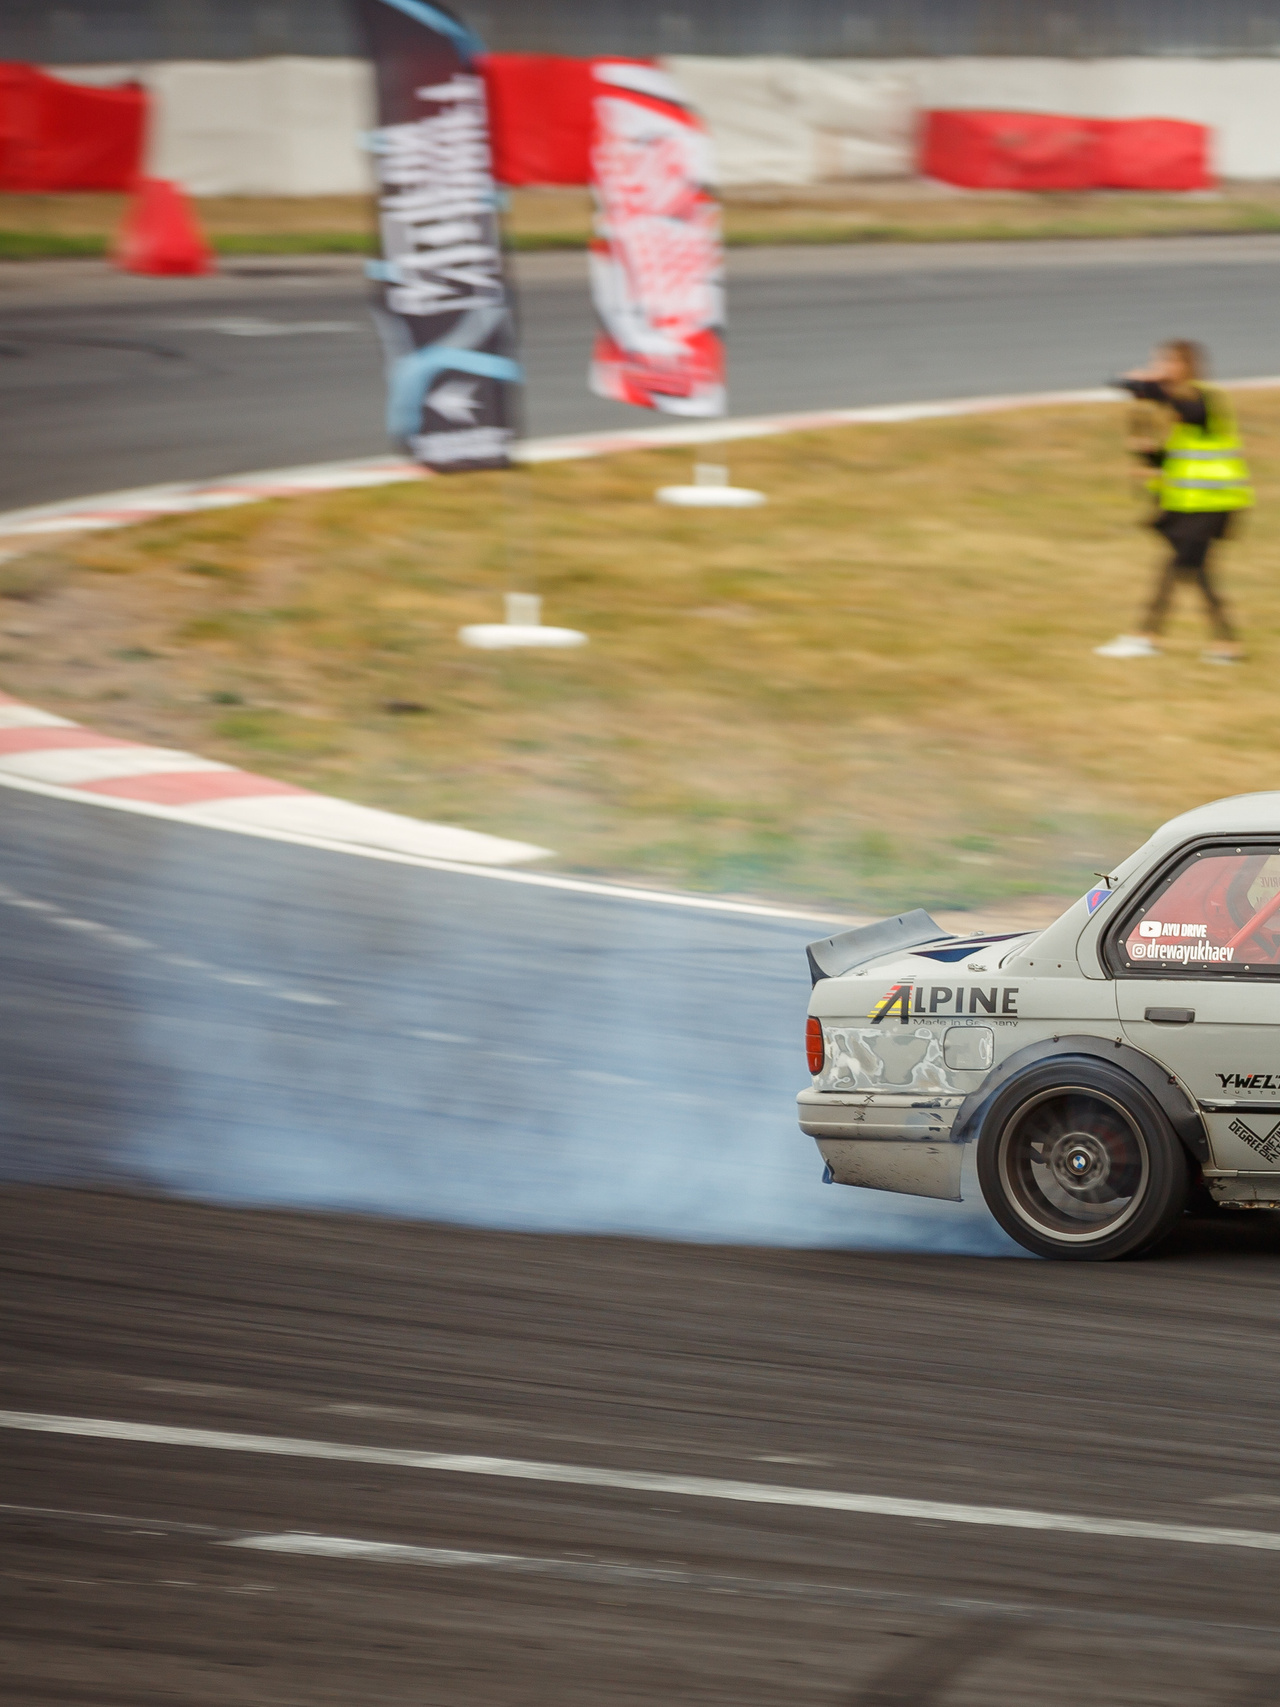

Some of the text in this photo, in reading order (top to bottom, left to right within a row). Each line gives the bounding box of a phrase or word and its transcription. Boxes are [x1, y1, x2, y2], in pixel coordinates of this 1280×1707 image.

[1161, 922, 1208, 938] AYU DRIVE
[1146, 938, 1235, 965] drewayukhaev
[868, 984, 1019, 1025] ALPINE
[1228, 1120, 1263, 1152] DEGREE
